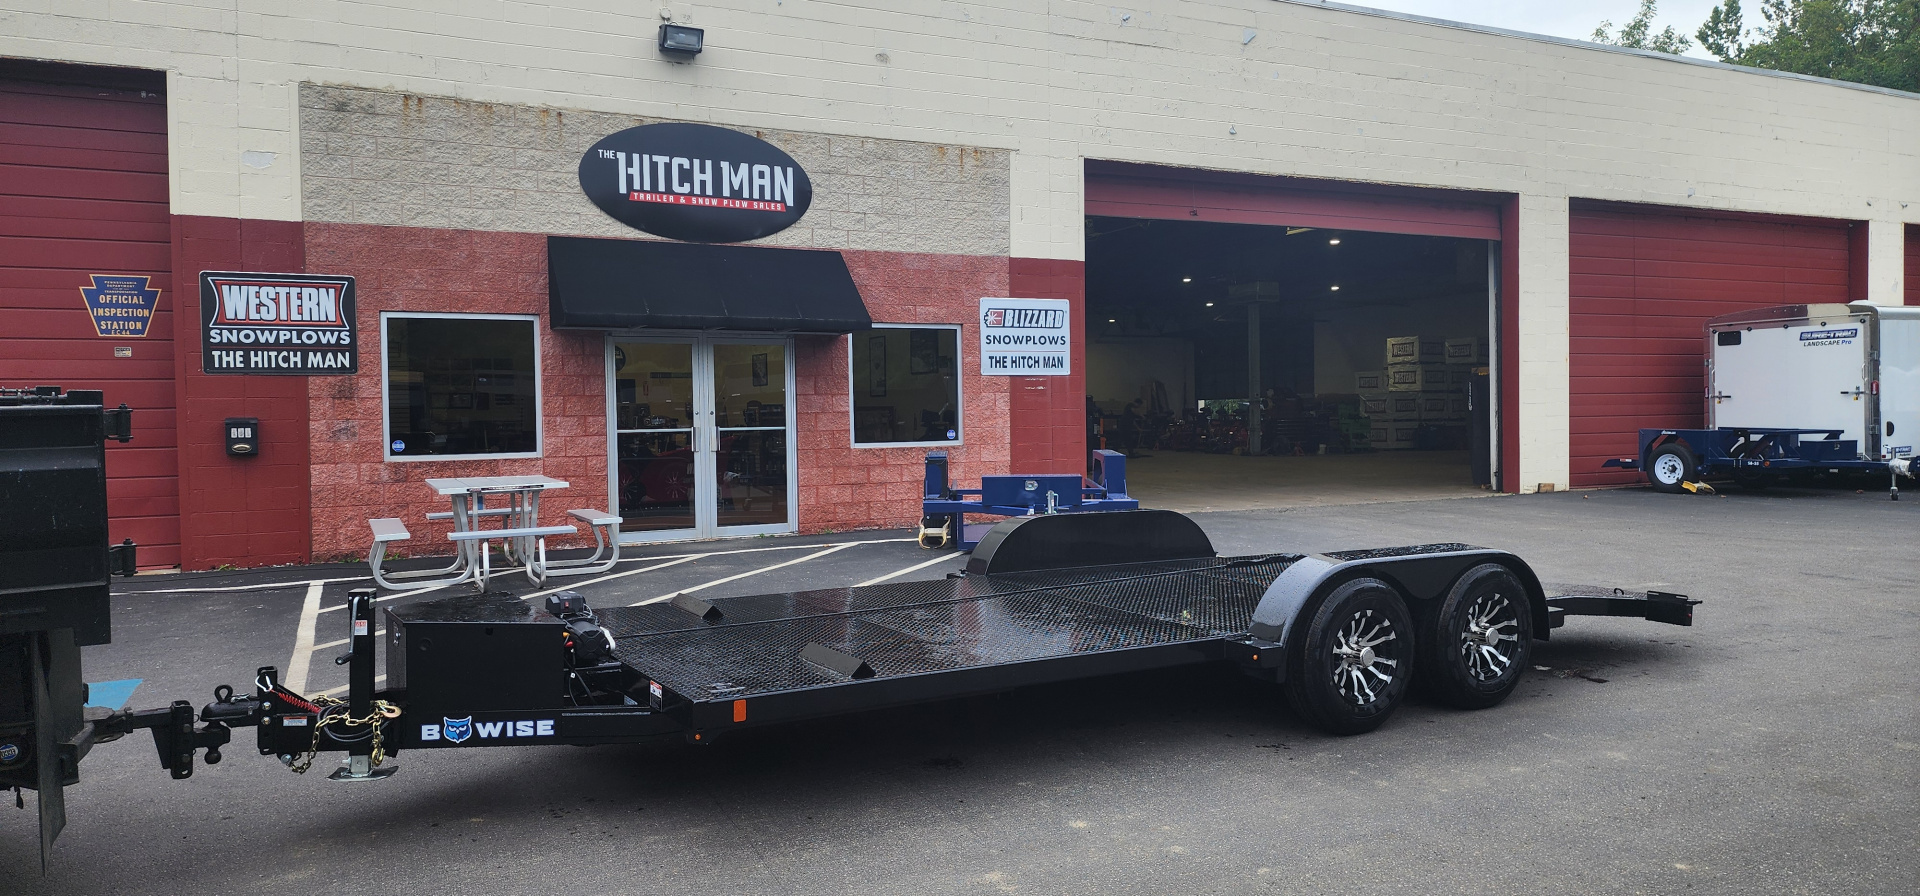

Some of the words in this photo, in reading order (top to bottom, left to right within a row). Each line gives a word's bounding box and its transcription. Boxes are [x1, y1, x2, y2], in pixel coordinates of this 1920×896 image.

[598, 149, 615, 159] THE
[616, 152, 713, 196] HITCH
[720, 161, 794, 207] MAN
[633, 192, 674, 203] TRAILER
[680, 196, 686, 204] &
[692, 197, 718, 206] SNOW
[723, 199, 748, 208] PLOW
[753, 201, 781, 211] SALES
[99, 294, 145, 304] OFFICIAL
[221, 285, 336, 322] WESTERN
[93, 307, 149, 317] INSPECTION
[1004, 309, 1064, 328] BLIZZARD
[100, 320, 142, 330] STATION
[209, 329, 351, 344] SNOWPLOWS
[985, 334, 1066, 345] SNOWPLOWS
[212, 350, 245, 368] THE
[250, 351, 302, 368] HITCH
[307, 351, 350, 368] MAN
[988, 355, 1008, 369] THE
[1010, 355, 1040, 369] HITCH
[1043, 355, 1064, 369] MAN
